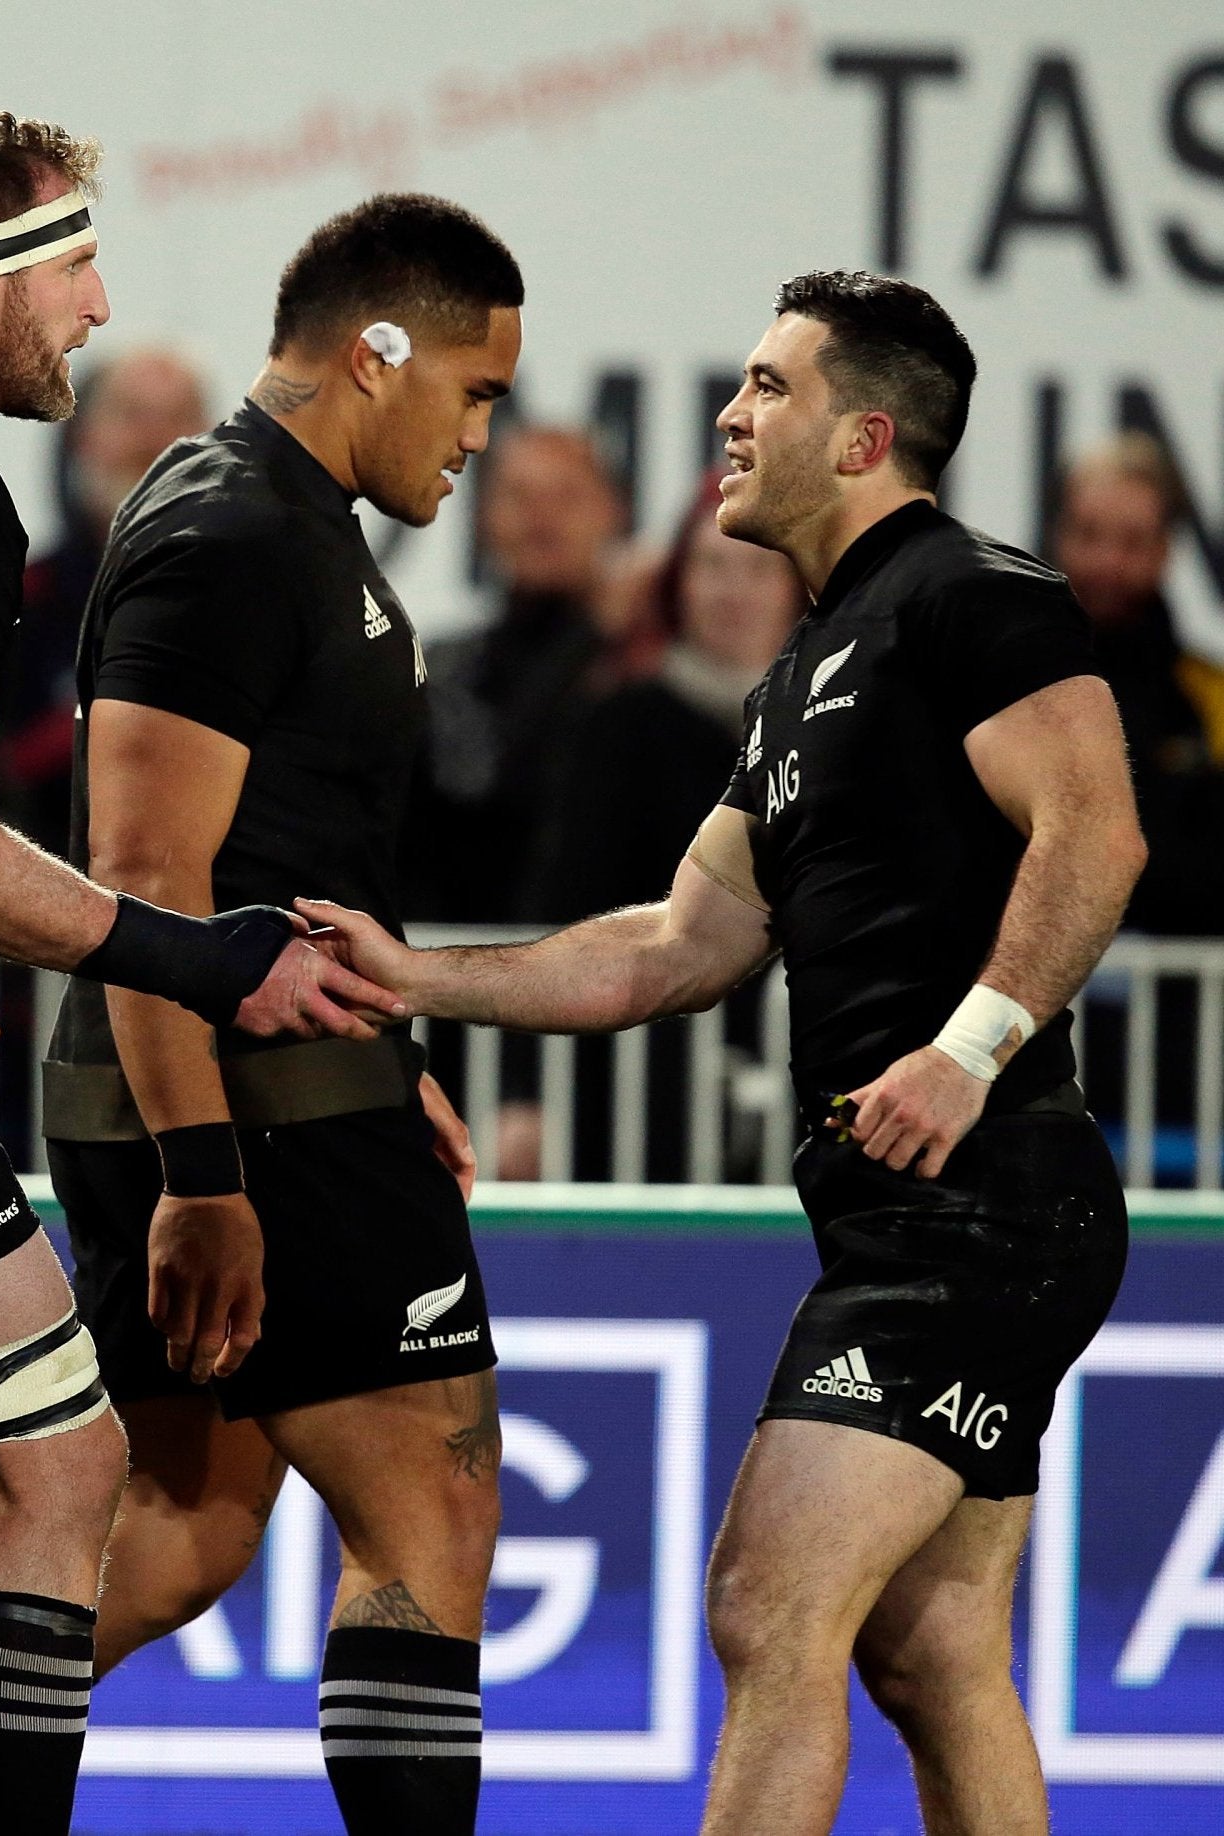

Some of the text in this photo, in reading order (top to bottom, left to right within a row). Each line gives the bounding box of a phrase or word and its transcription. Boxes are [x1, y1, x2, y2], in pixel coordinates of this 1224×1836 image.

[766, 749, 800, 824] AIG
[399, 1329, 479, 1352] ALL BLACKS
[802, 1377, 883, 1402] adidas
[920, 1381, 1008, 1450] AIG
